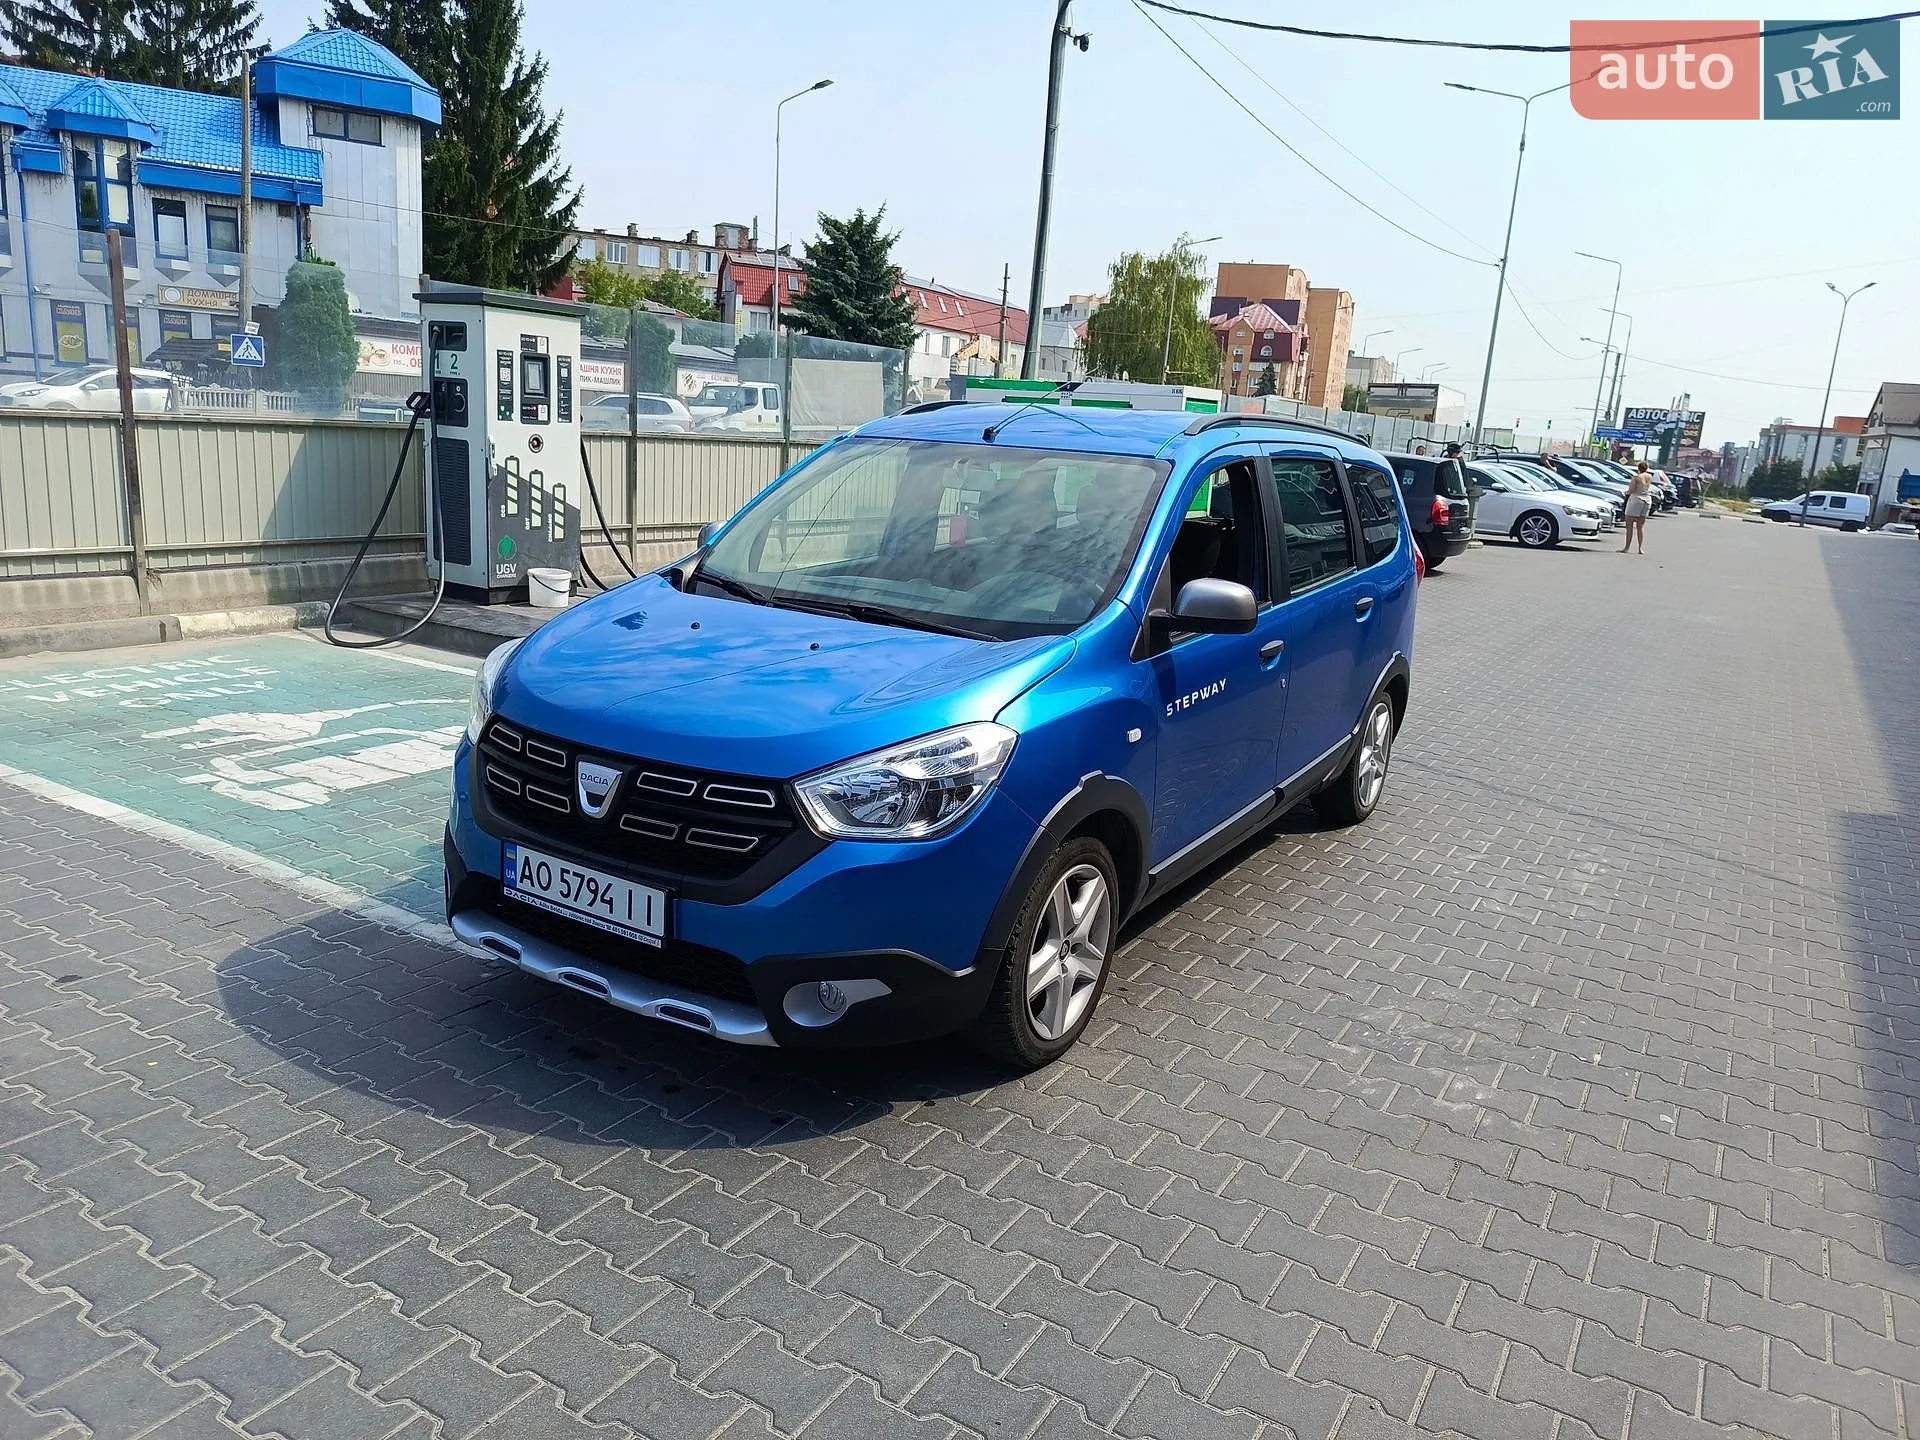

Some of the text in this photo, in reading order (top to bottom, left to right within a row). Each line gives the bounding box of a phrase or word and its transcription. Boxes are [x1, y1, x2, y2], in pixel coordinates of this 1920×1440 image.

[186, 298, 218, 307] КУХНЯ
[450, 353, 458, 370] 2
[600, 365, 622, 376] КУХНЯ
[496, 563, 517, 574] UGV
[24, 665, 280, 703] VEHICLE
[118, 680, 273, 708] ONLY
[1166, 678, 1227, 717] STEPWAY
[581, 772, 609, 786] DACIA
[505, 868, 516, 881] UA
[519, 855, 552, 892] AO
[559, 867, 614, 915] 5794
